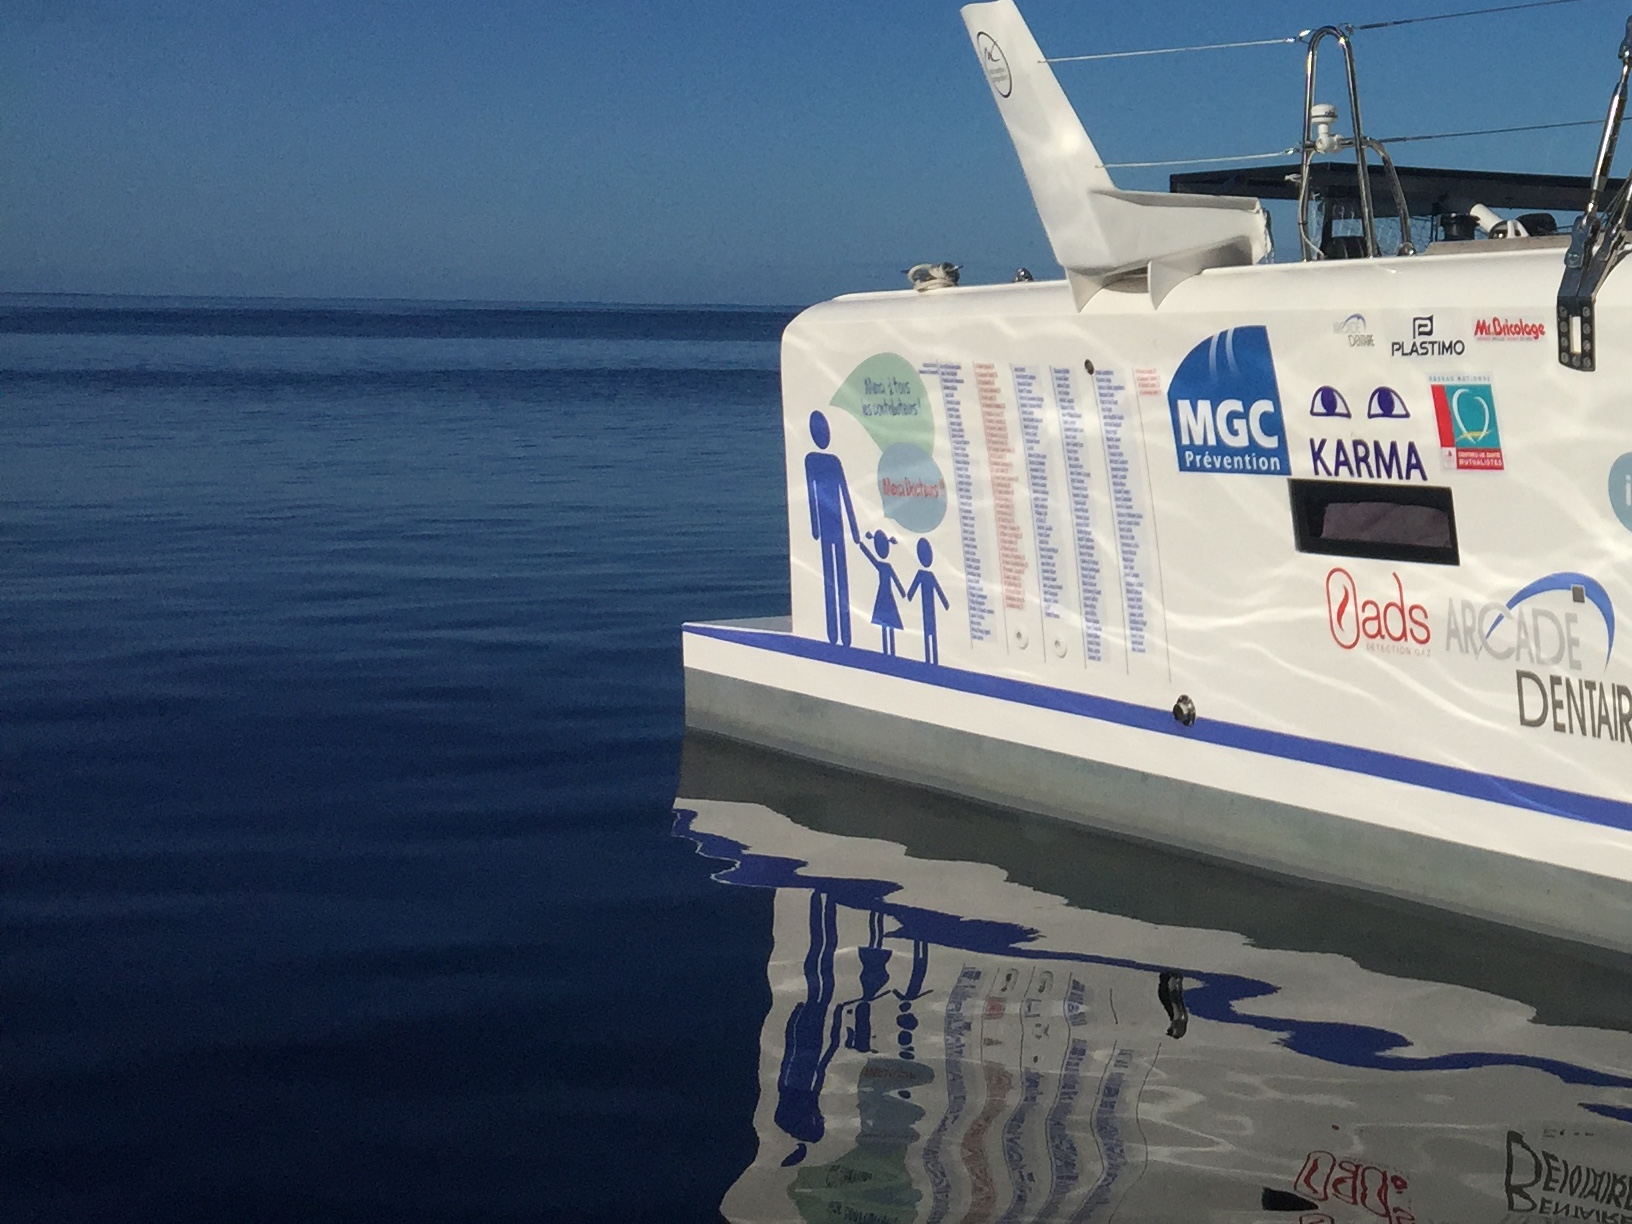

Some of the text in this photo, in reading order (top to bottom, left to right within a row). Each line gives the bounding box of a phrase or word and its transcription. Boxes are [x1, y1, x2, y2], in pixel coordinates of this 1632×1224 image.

[1391, 339, 1466, 357] PLASTIMO
[1177, 399, 1279, 448] MGC
[1185, 451, 1281, 471] Prévention
[1309, 438, 1428, 481] KARMA
[1445, 597, 1583, 671] ARCADE
